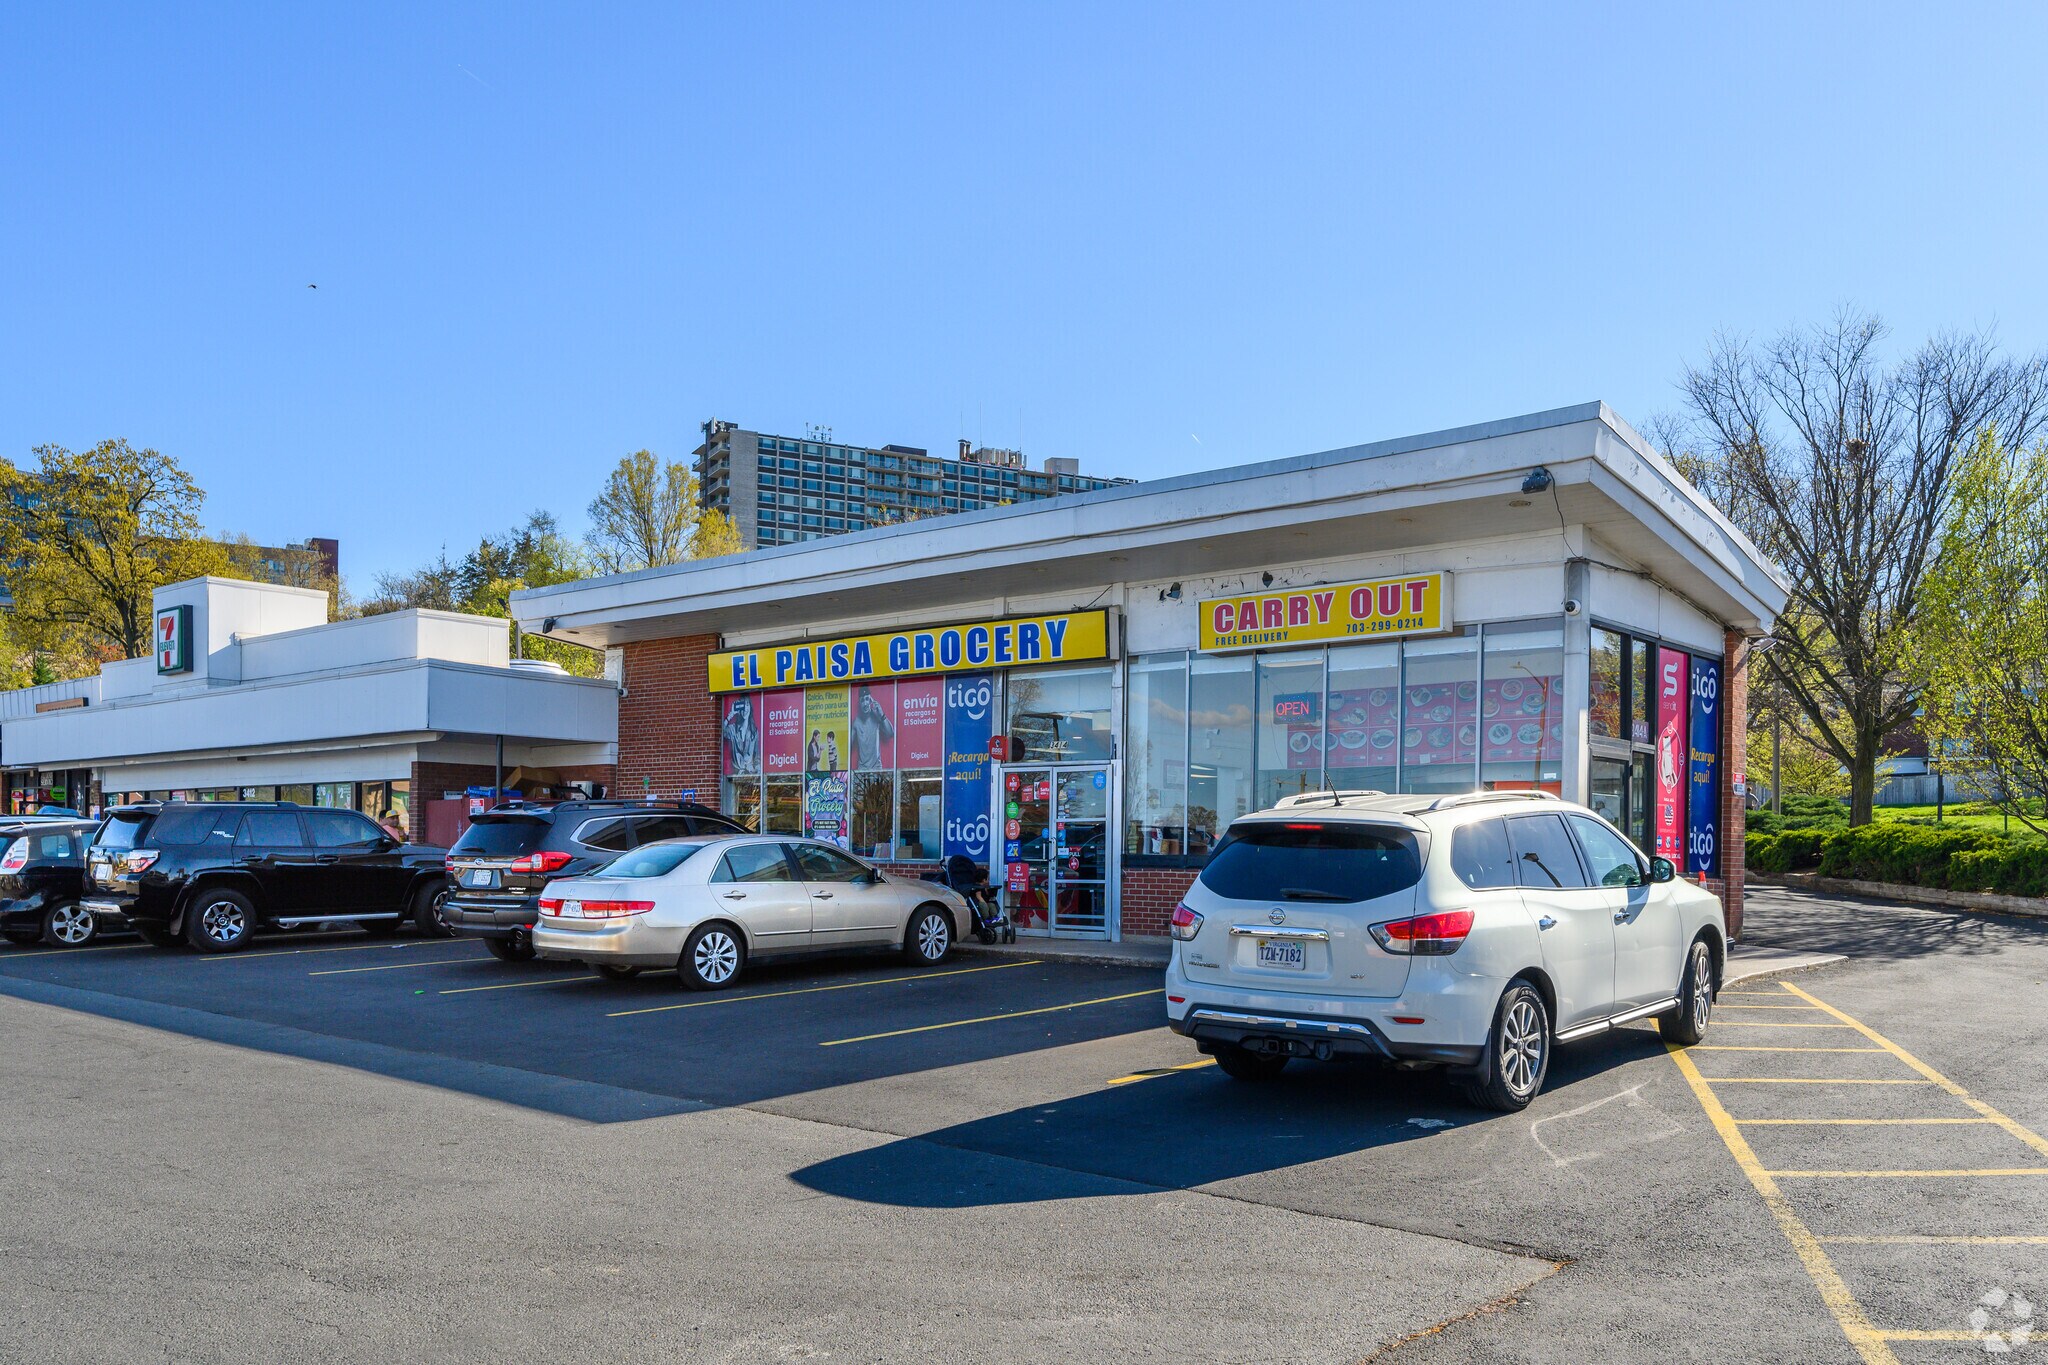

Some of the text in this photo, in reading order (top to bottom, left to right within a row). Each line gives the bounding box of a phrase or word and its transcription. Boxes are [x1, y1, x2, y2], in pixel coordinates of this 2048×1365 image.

[1213, 579, 1429, 634] CARRY OUT
[1346, 617, 1423, 633] 703-299-0214
[160, 615, 174, 667] 7
[1216, 631, 1288, 646] FREE DELIVERY
[732, 618, 1069, 688] EL PAISA GROCERY
[825, 692, 839, 700] fibra
[903, 693, 938, 709] envía
[769, 706, 799, 720] envía
[825, 703, 838, 711] para
[905, 710, 930, 718] recargas
[1276, 701, 1309, 716] OPEN
[910, 718, 937, 726] Salvador
[769, 753, 799, 767] Digicel
[911, 752, 929, 760] Digicel
[948, 751, 989, 765] ¡Recarga
[956, 768, 981, 783] aquí!
[810, 798, 844, 817] Grocery
